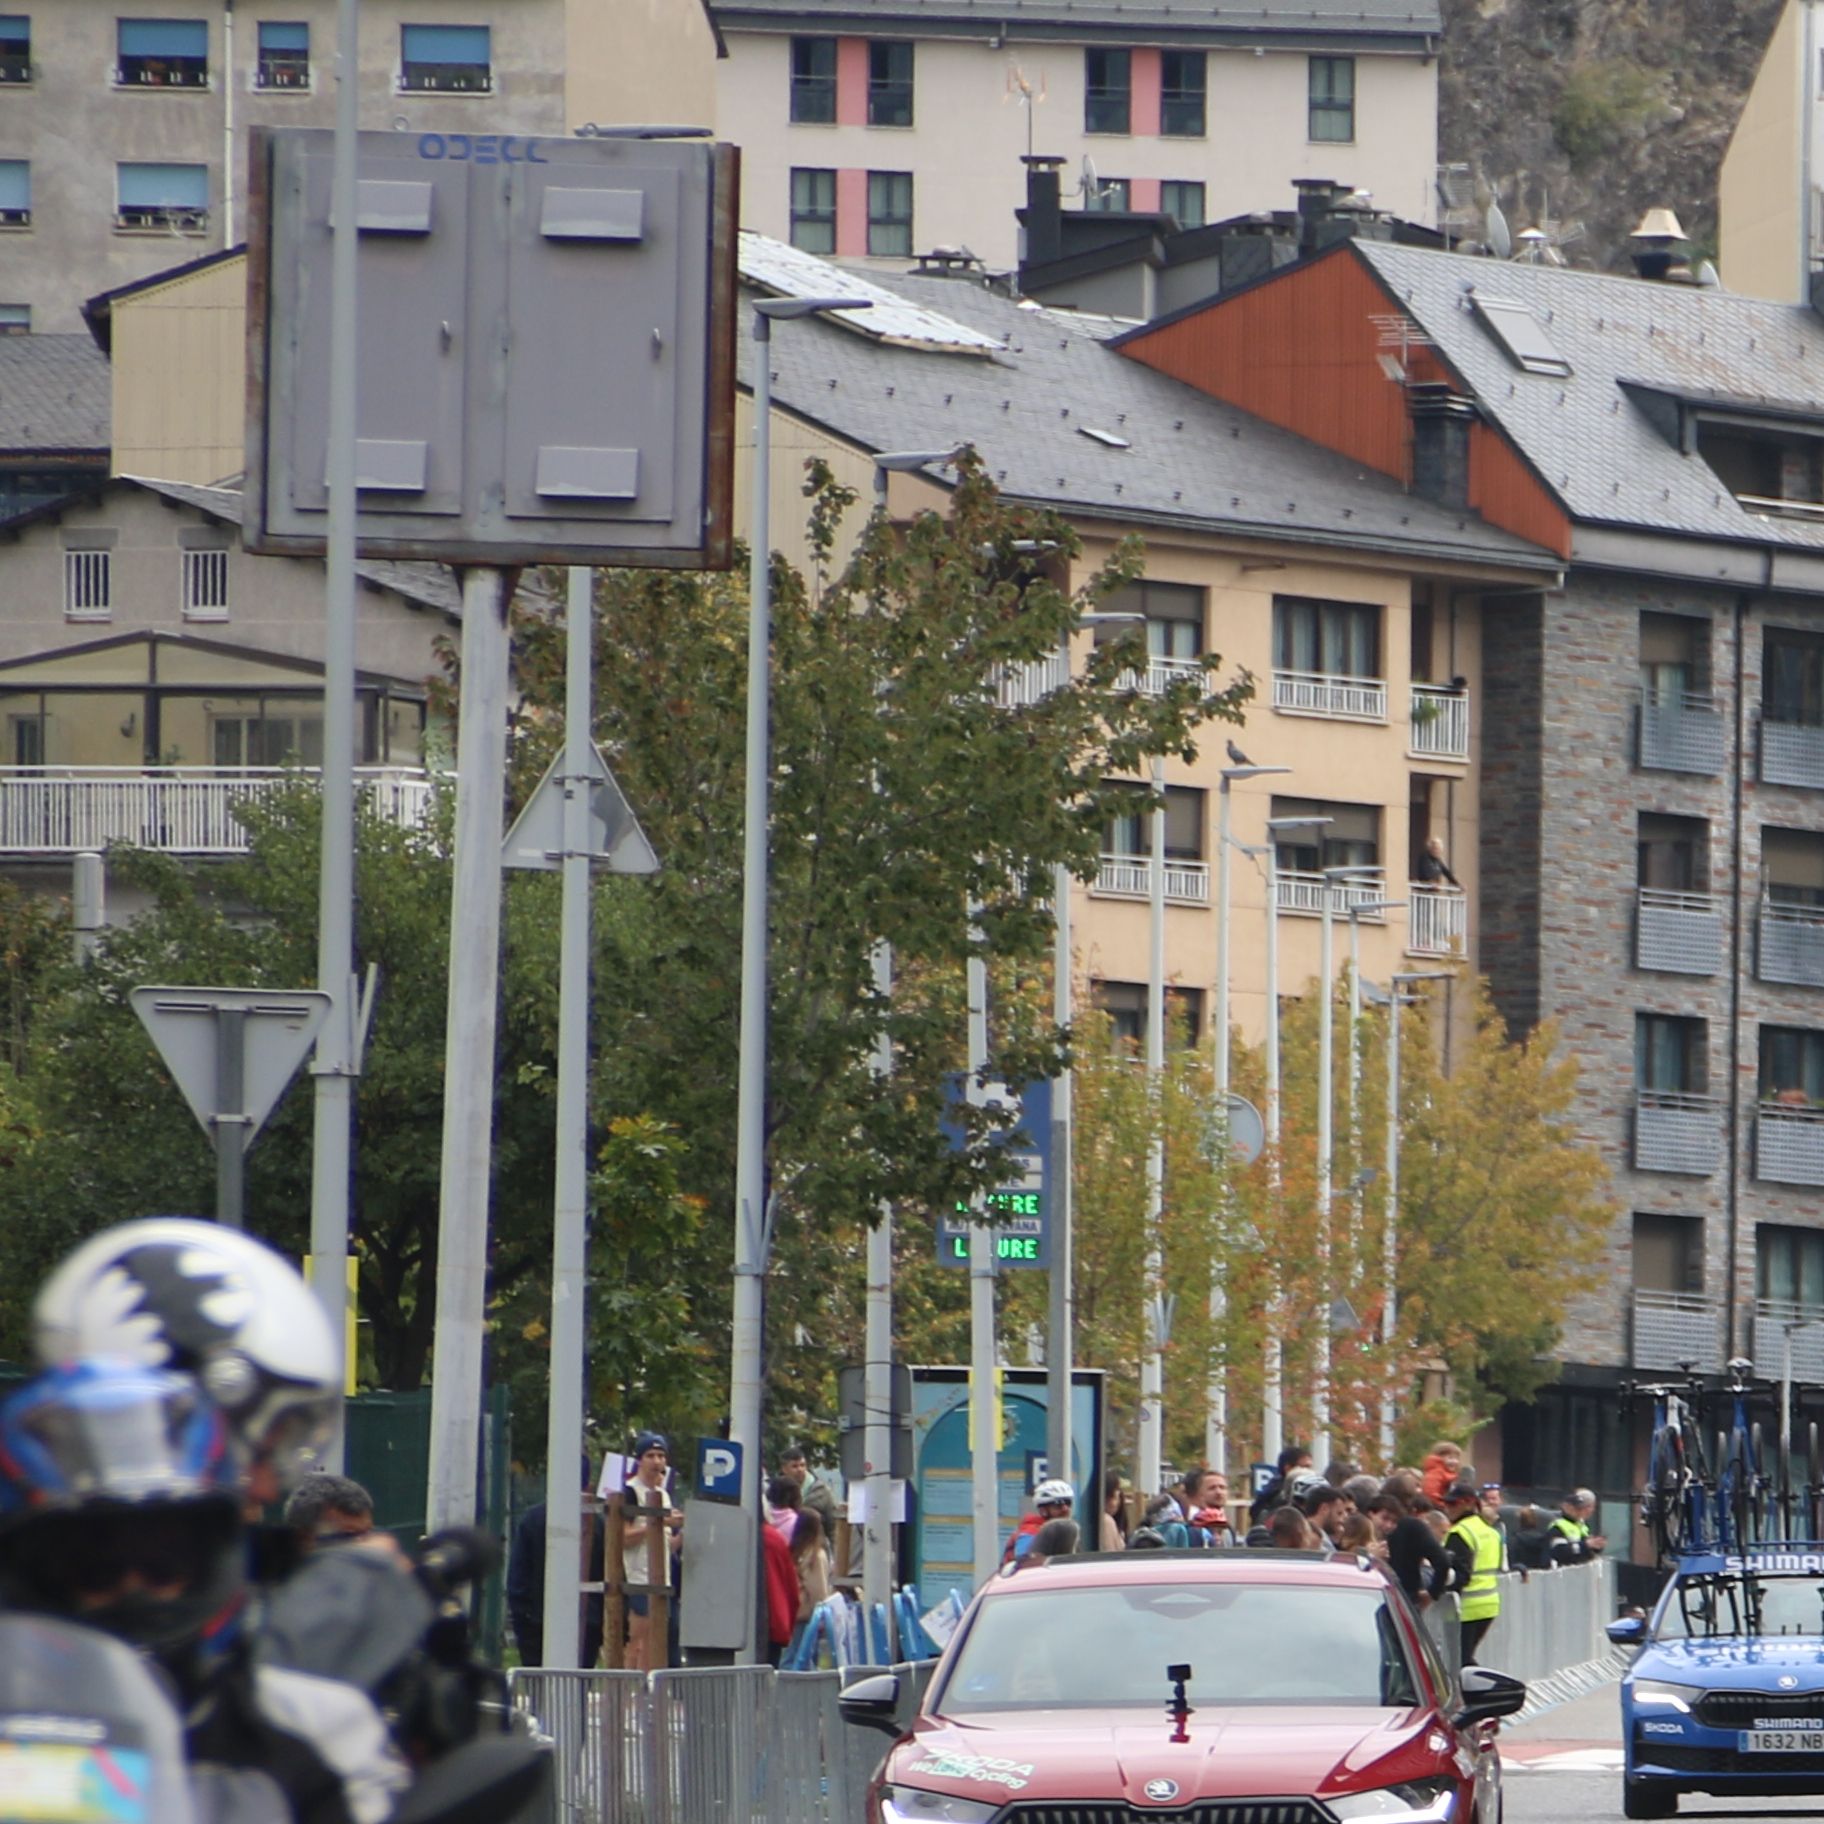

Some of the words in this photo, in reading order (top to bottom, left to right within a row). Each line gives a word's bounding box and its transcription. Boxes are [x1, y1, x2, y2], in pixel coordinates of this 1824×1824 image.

[954, 1237, 1038, 1259] LURE
[1753, 1717, 1824, 1730] SHIMANO
[1753, 1732, 1796, 1750] 1632
